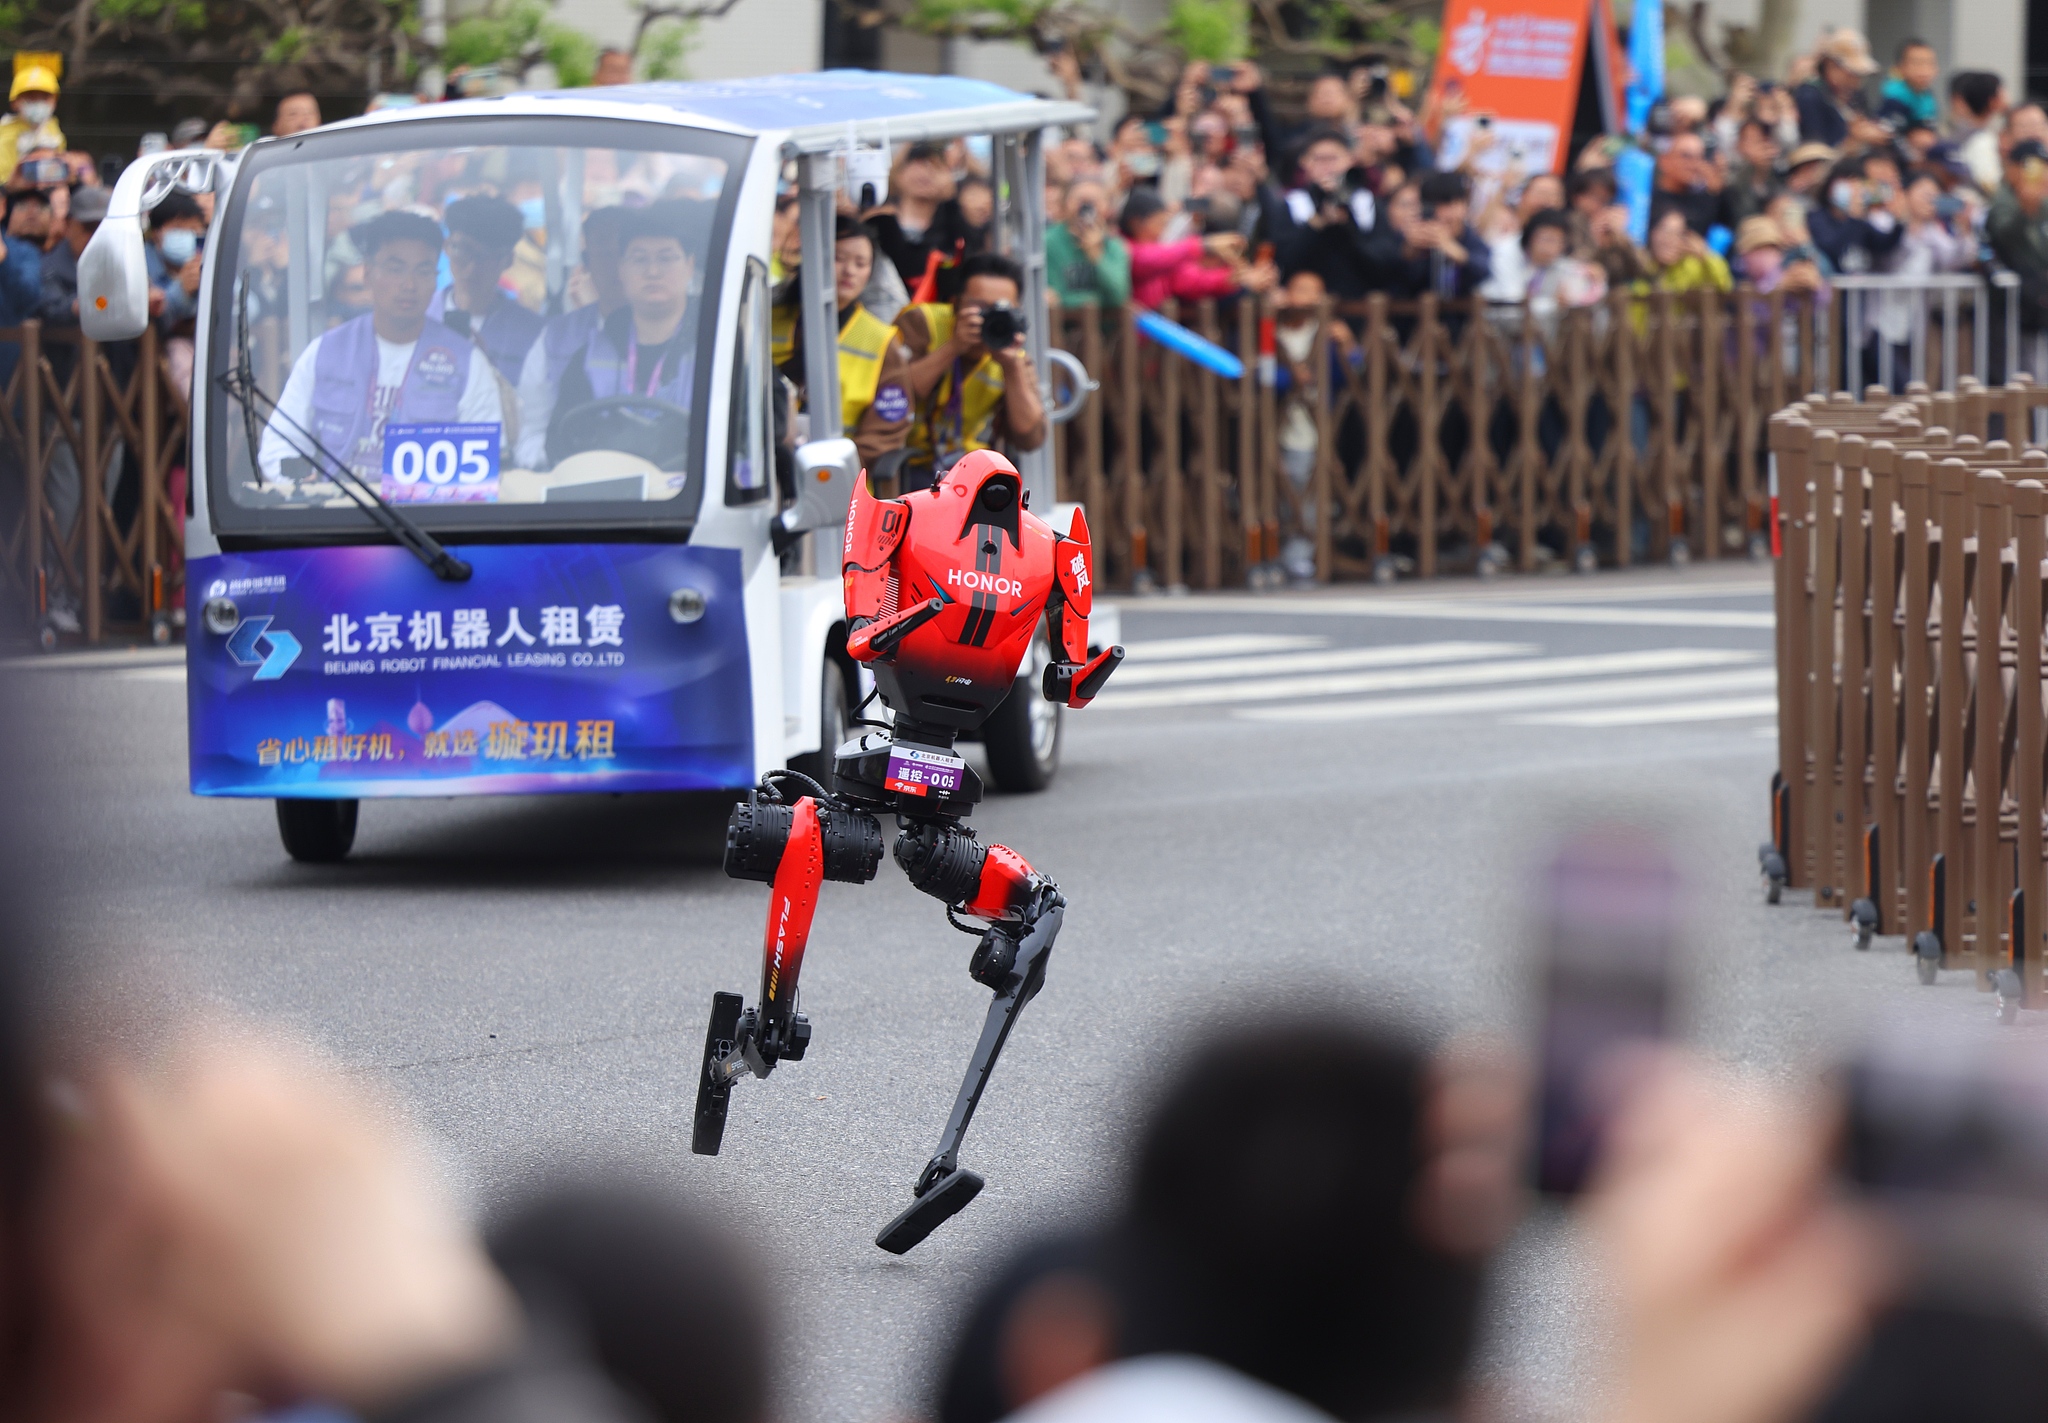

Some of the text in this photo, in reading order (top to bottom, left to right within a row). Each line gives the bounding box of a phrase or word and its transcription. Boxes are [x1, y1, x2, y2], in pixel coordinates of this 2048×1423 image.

[391, 440, 491, 485] 005
[845, 499, 858, 554] HONOR
[947, 568, 1023, 598] HONOR
[322, 604, 626, 655] 北京机器人租赁
[324, 660, 376, 675] BEIJING
[381, 657, 428, 674] ROBOT
[433, 654, 502, 670] FINANCIAL
[507, 652, 567, 667] LEASING
[903, 785, 917, 793] 京东
[774, 896, 791, 969] FLASH
